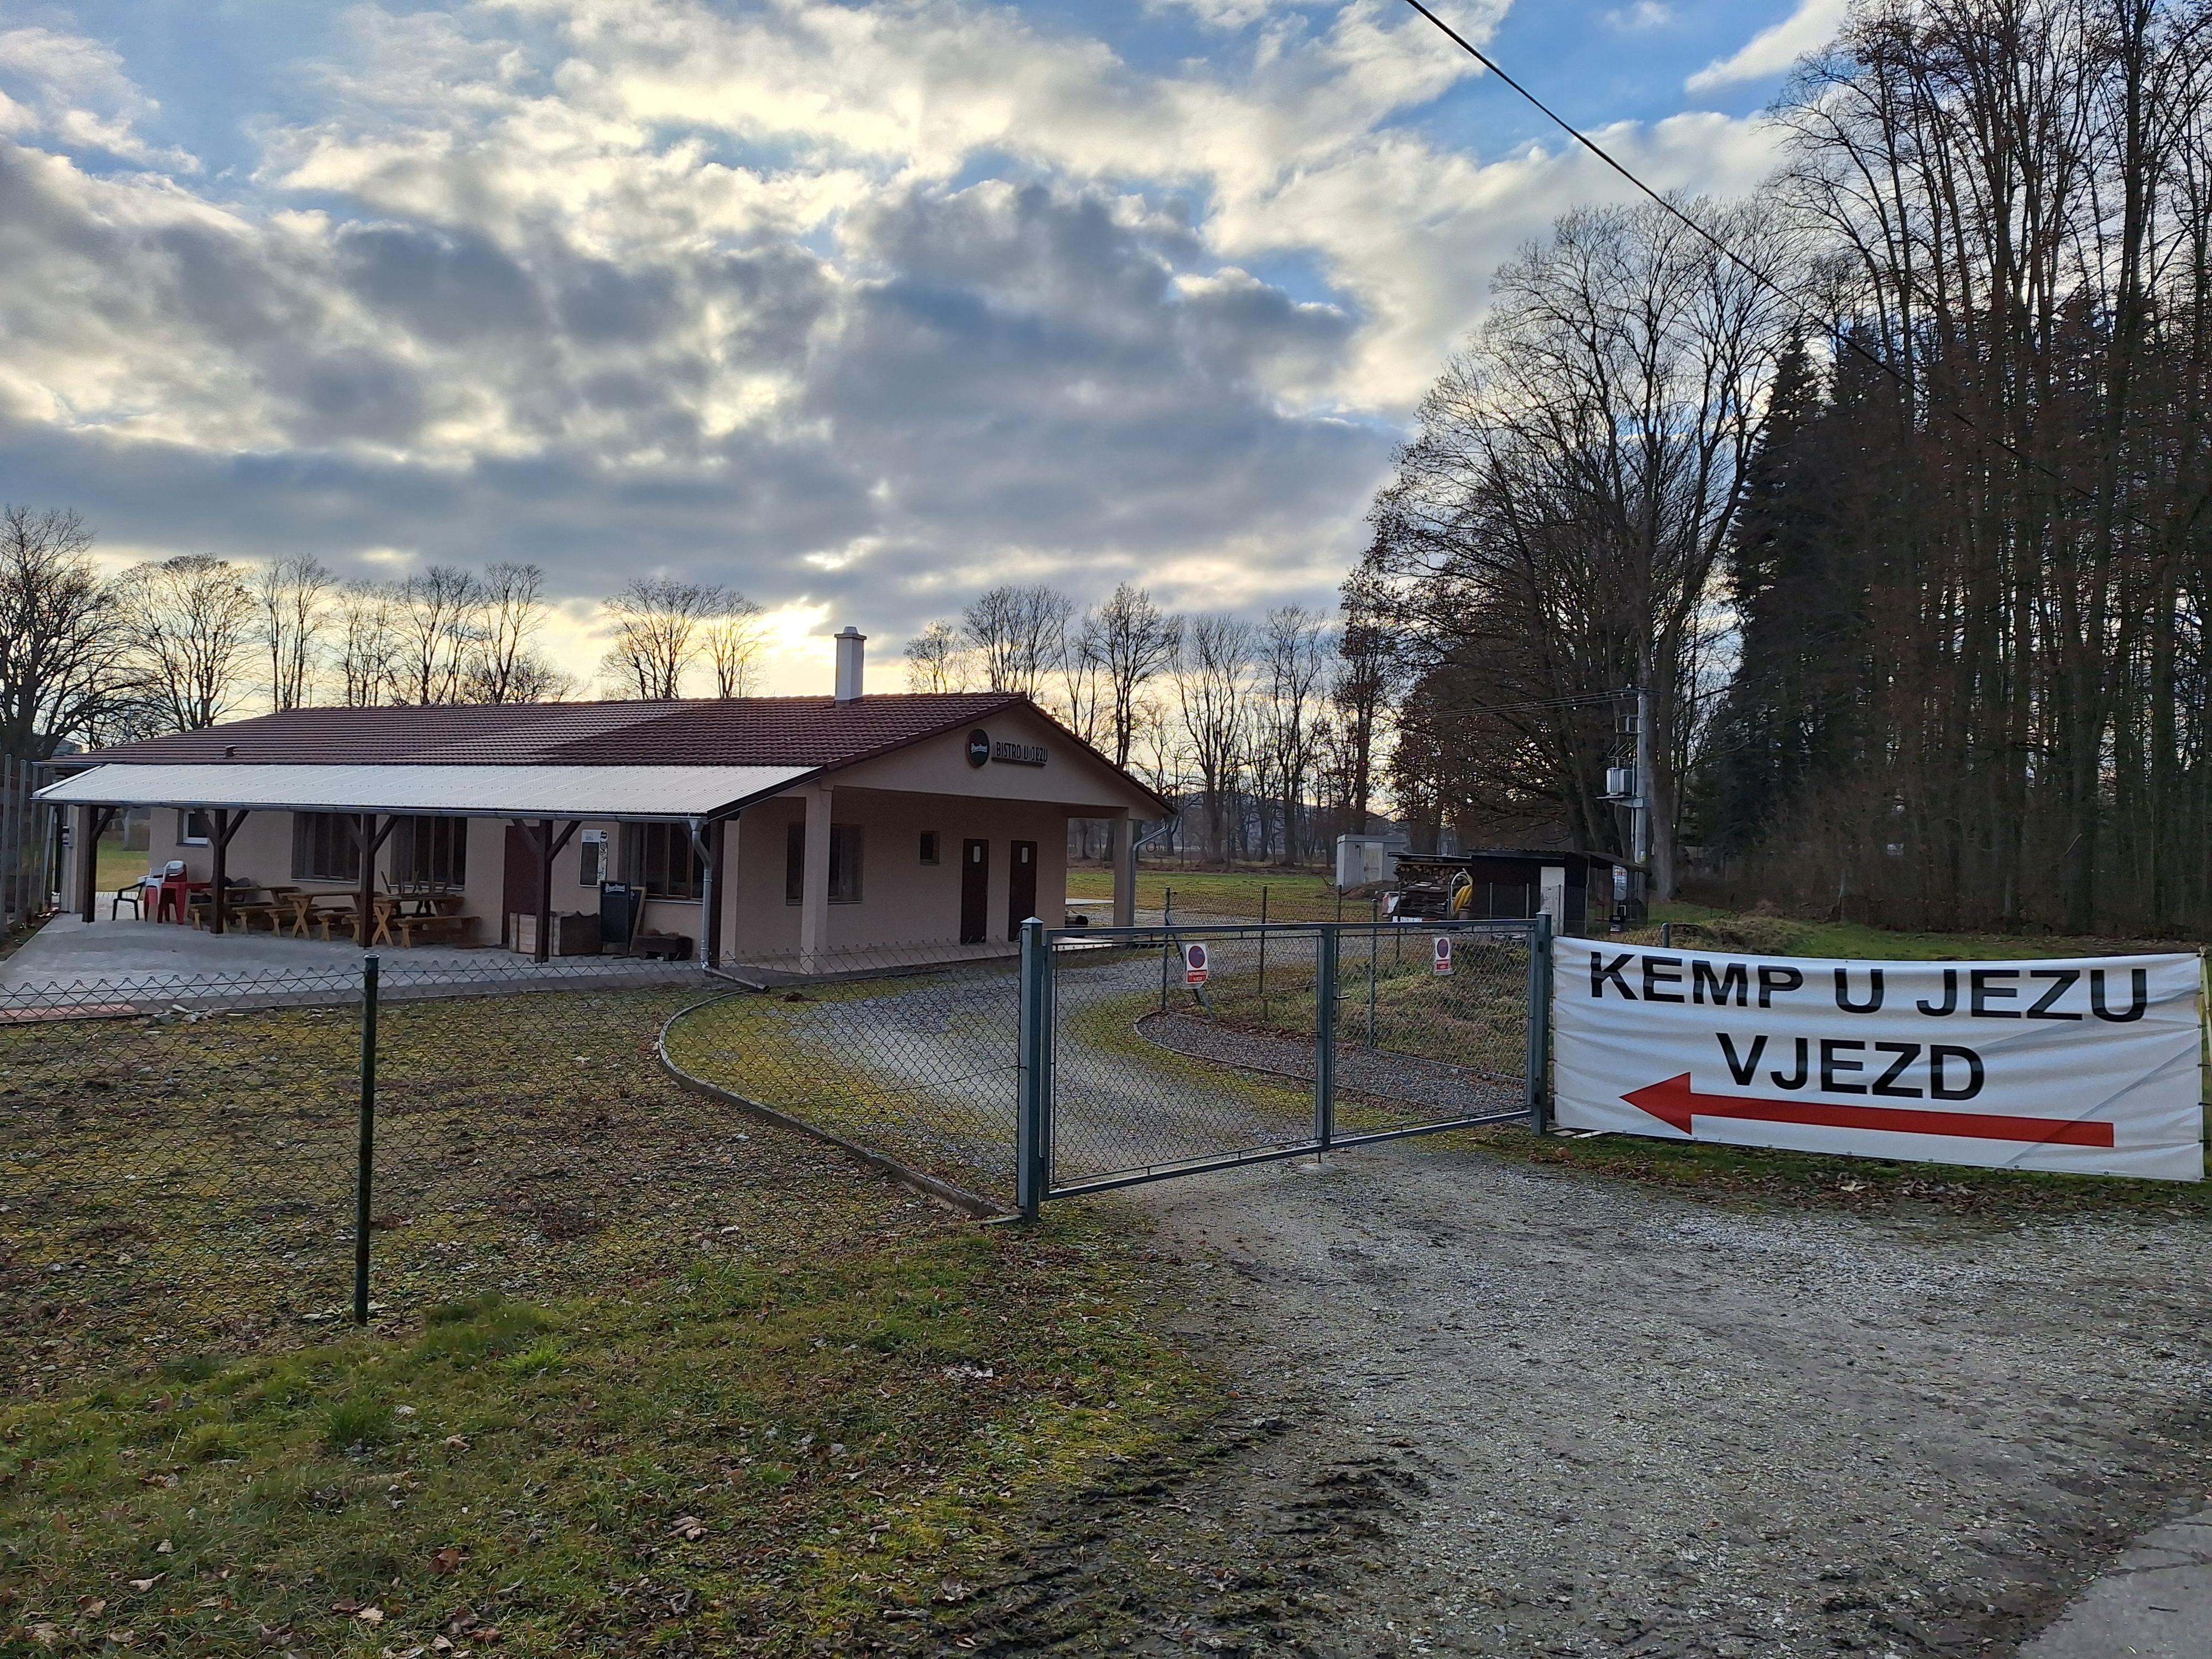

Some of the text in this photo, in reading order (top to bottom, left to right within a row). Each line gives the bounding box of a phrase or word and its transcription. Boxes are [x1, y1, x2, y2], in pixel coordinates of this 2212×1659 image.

[996, 742, 1021, 759] BISTRO
[1024, 745, 1029, 760] U
[1031, 746, 1048, 763] JEZU
[1590, 951, 2147, 1022] KEMP U JEZU
[1715, 1032, 1985, 1100] VJEZD
